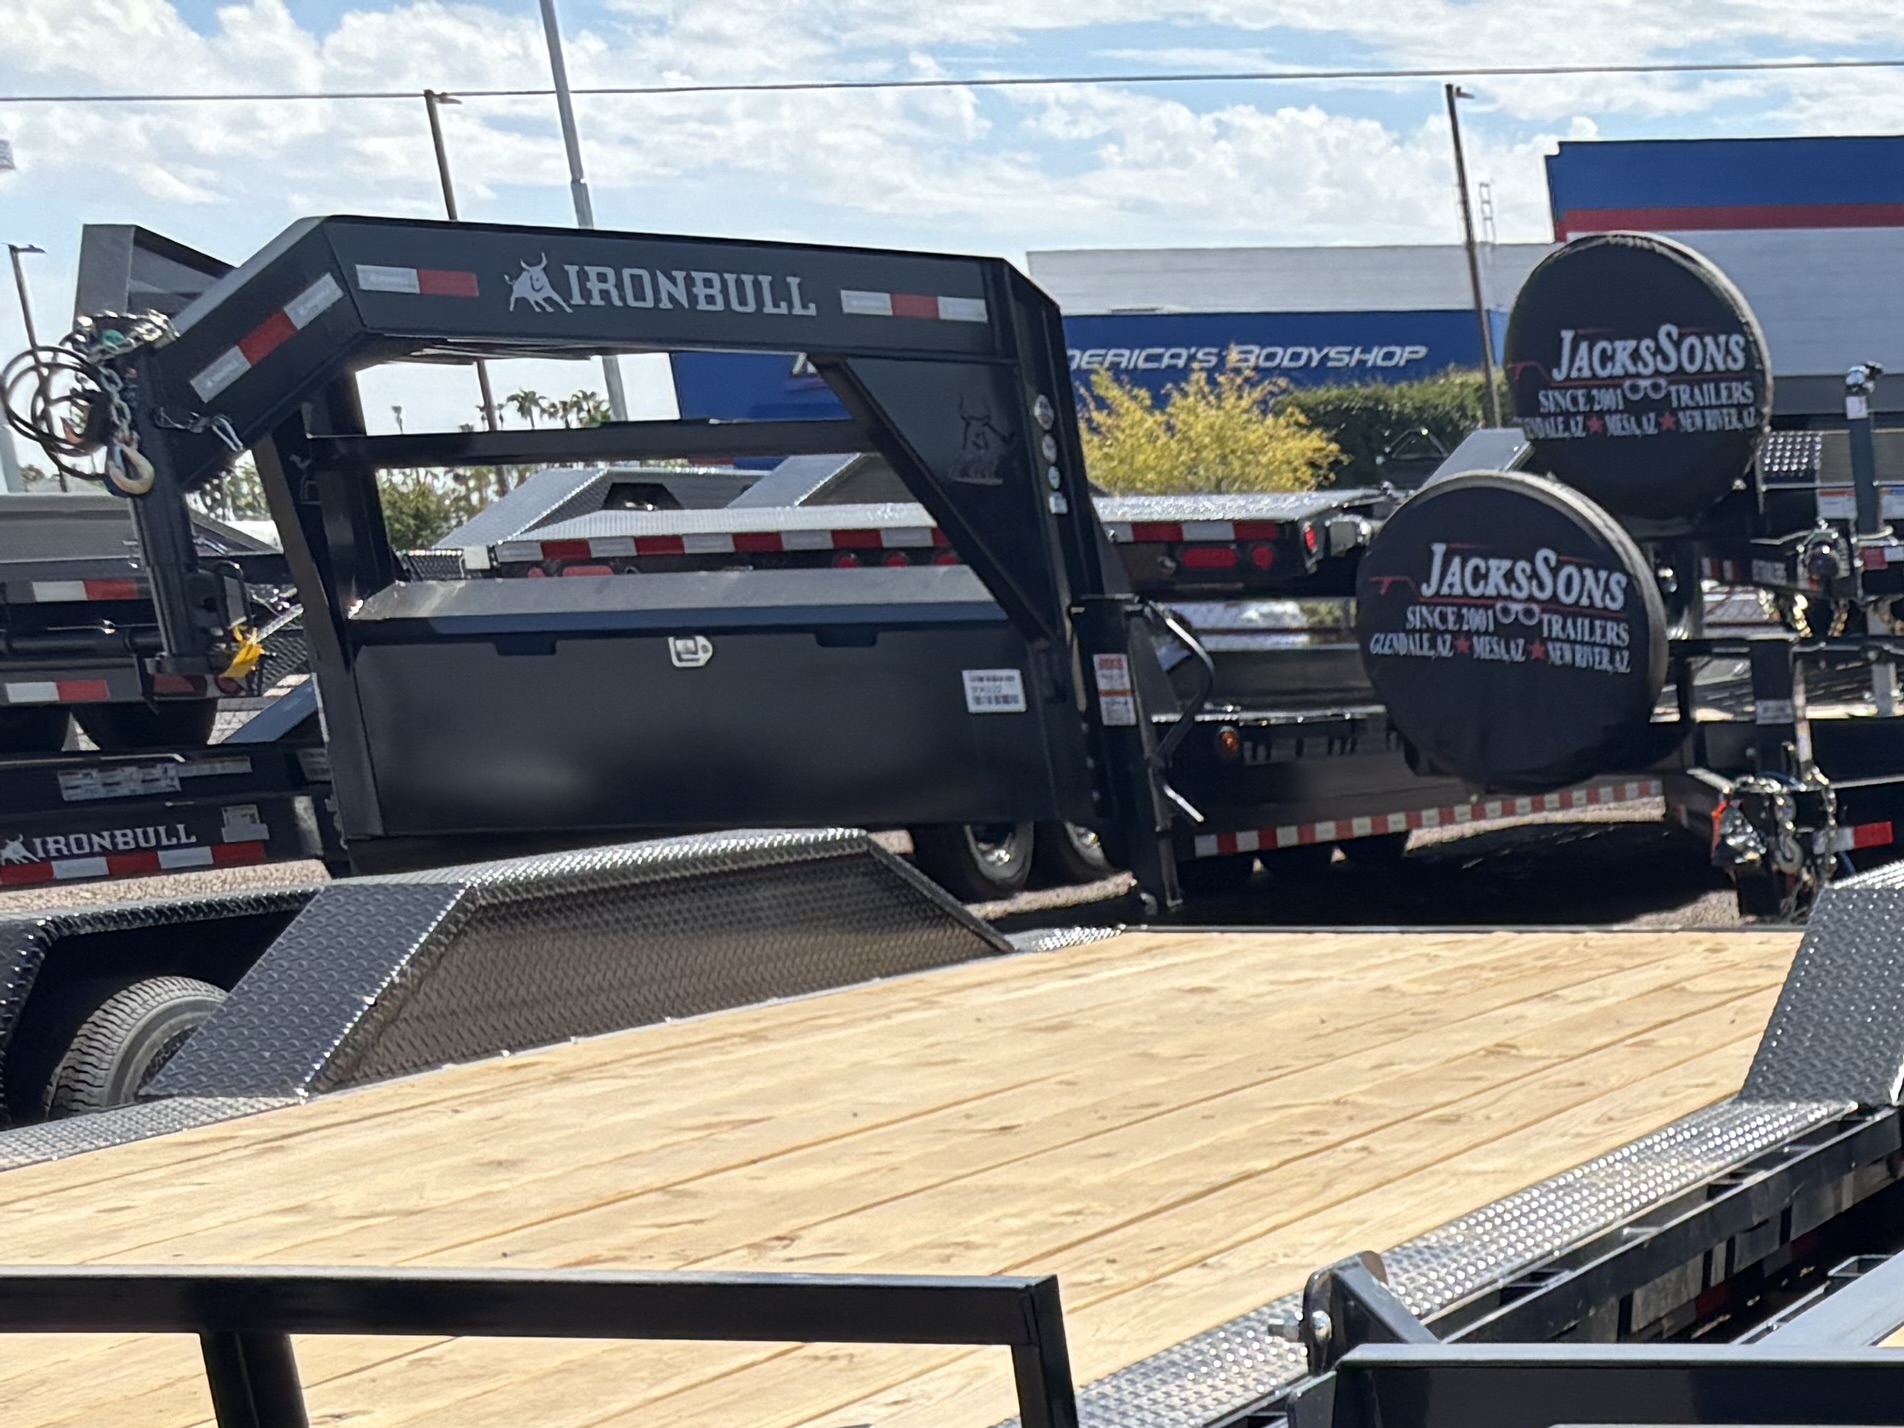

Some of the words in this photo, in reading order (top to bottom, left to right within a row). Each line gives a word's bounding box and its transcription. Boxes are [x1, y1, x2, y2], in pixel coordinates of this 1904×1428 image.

[563, 263, 817, 317] IRONBULL
[1538, 387, 1591, 414] SINCE
[1669, 381, 1755, 409] TRAILERS
[1405, 605, 1459, 632] SINCE
[1461, 606, 1495, 633] 2001
[1541, 612, 1630, 648] TRAILERS
[32, 824, 197, 858] IRONBULL
